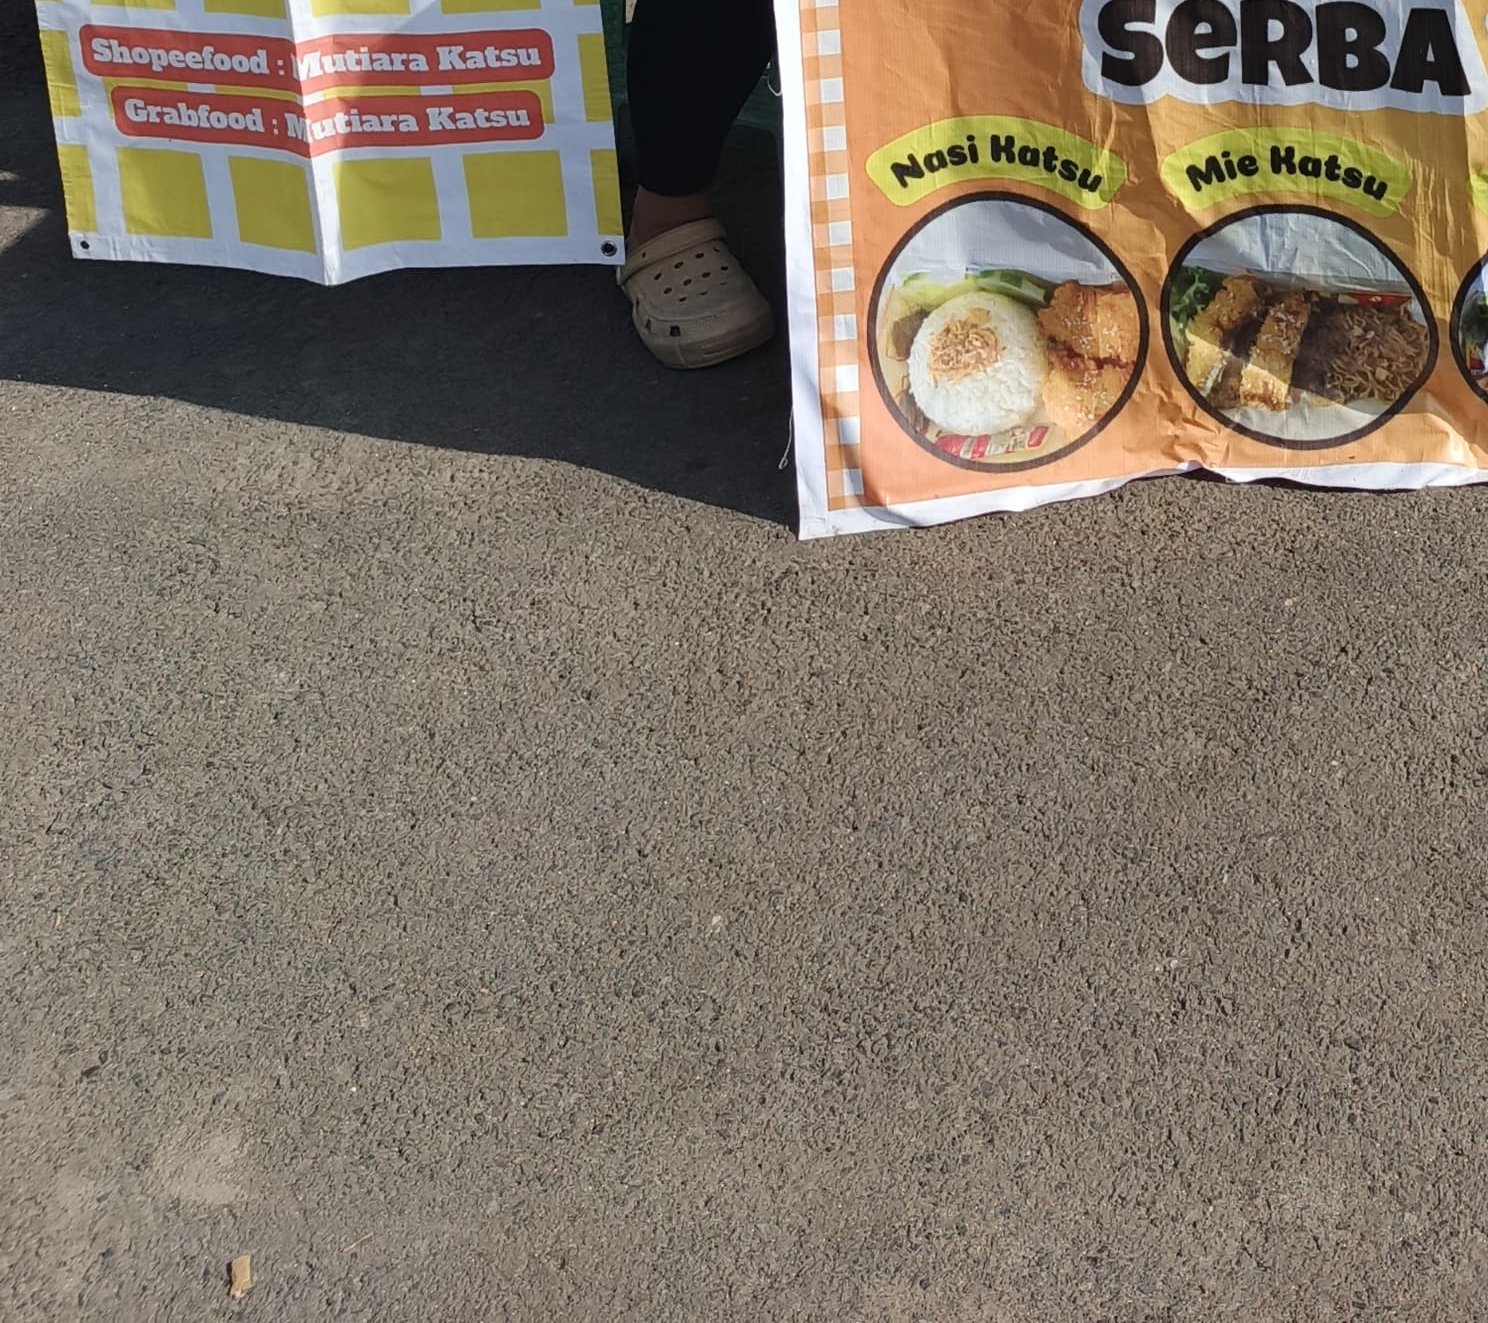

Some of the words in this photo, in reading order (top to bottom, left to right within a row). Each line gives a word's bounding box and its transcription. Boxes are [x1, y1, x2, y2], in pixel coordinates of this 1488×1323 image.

[91, 37, 268, 75] Shopeefood
[292, 43, 429, 81] Mutiara
[436, 45, 541, 70] Katsu
[124, 98, 265, 133] Grabfood
[287, 111, 419, 143] Mutiara
[427, 106, 530, 131] Katsu
[890, 135, 979, 188] Nasi
[990, 135, 1103, 193] Katsu
[1185, 153, 1260, 193] Mie
[1270, 145, 1388, 201] Katsu
